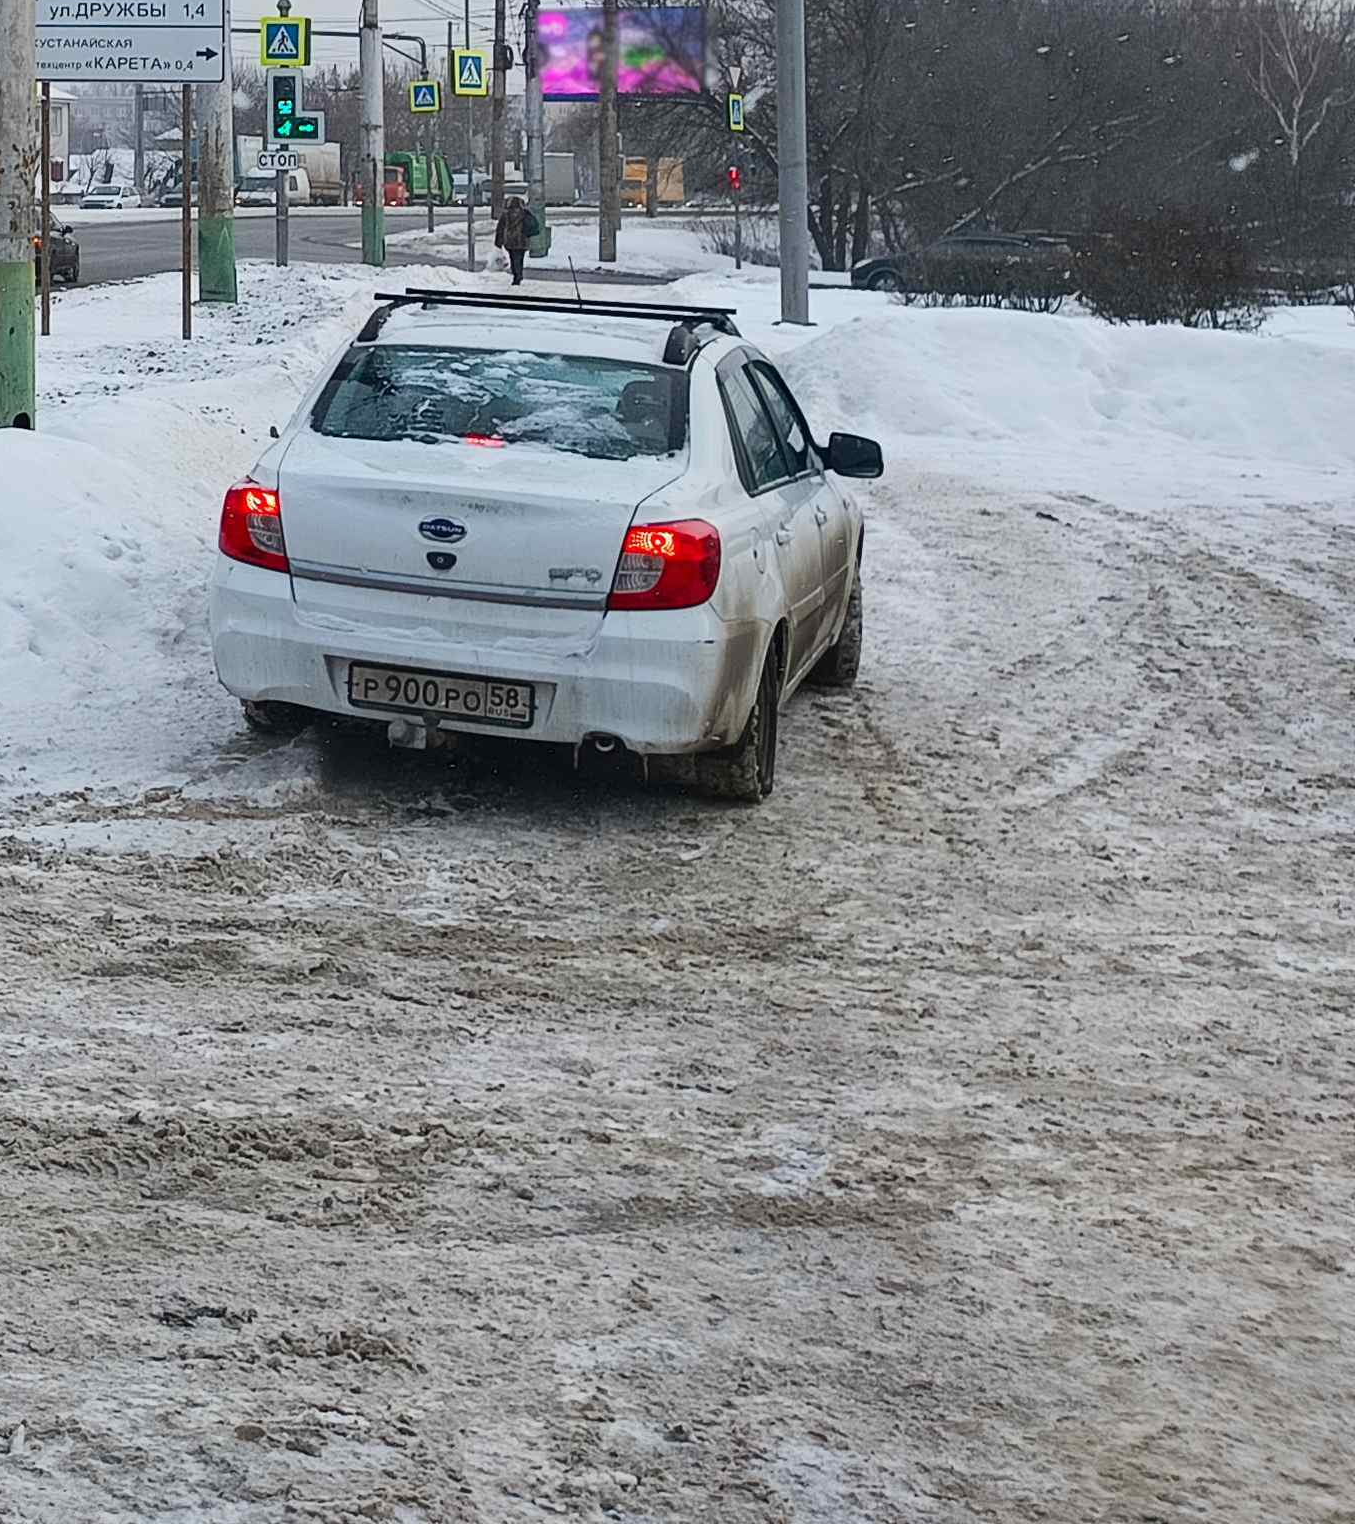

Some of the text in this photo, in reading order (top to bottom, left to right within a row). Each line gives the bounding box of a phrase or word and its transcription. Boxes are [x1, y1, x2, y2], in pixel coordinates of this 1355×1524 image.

[183, 3, 205, 19] 1,4
[85, 57, 171, 70] «КАРЕТА»
[175, 61, 194, 72] 0,4
[259, 154, 297, 166] СТОП
[422, 523, 463, 534] DATSUN
[491, 686, 519, 709] 58
